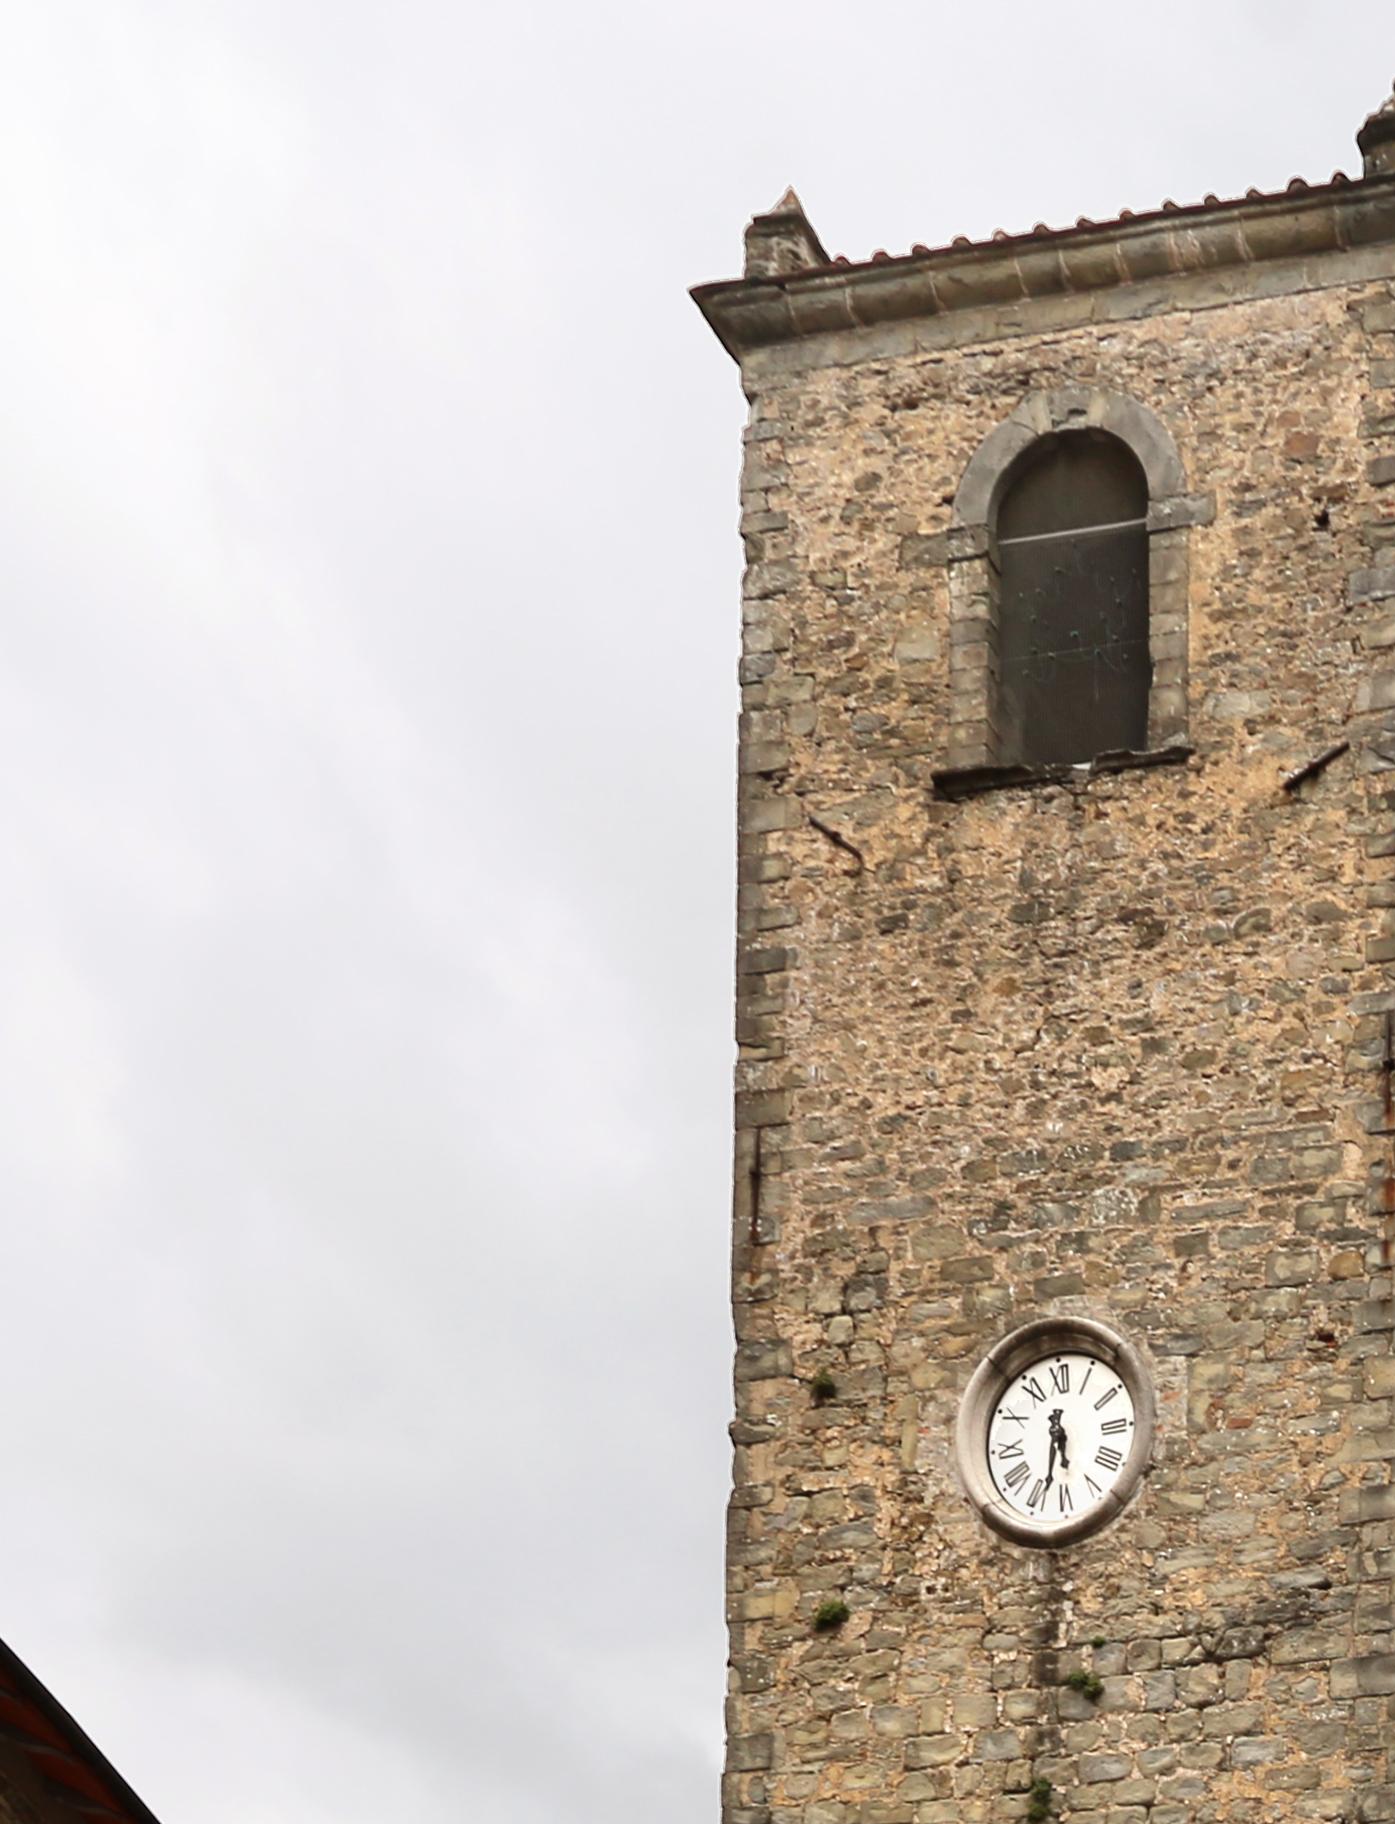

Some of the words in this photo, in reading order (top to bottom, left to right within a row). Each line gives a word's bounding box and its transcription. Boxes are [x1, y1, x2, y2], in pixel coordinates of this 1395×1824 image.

[1049, 1363, 1070, 1396] XII
[1021, 1376, 1047, 1409] XI
[1093, 1387, 1118, 1411] II
[1002, 1407, 1030, 1429] X
[1101, 1418, 1127, 1436] III
[997, 1438, 1025, 1460] IX
[1004, 1460, 1031, 1496] VIII
[1083, 1473, 1102, 1498] V
[1059, 1483, 1074, 1512] VI
